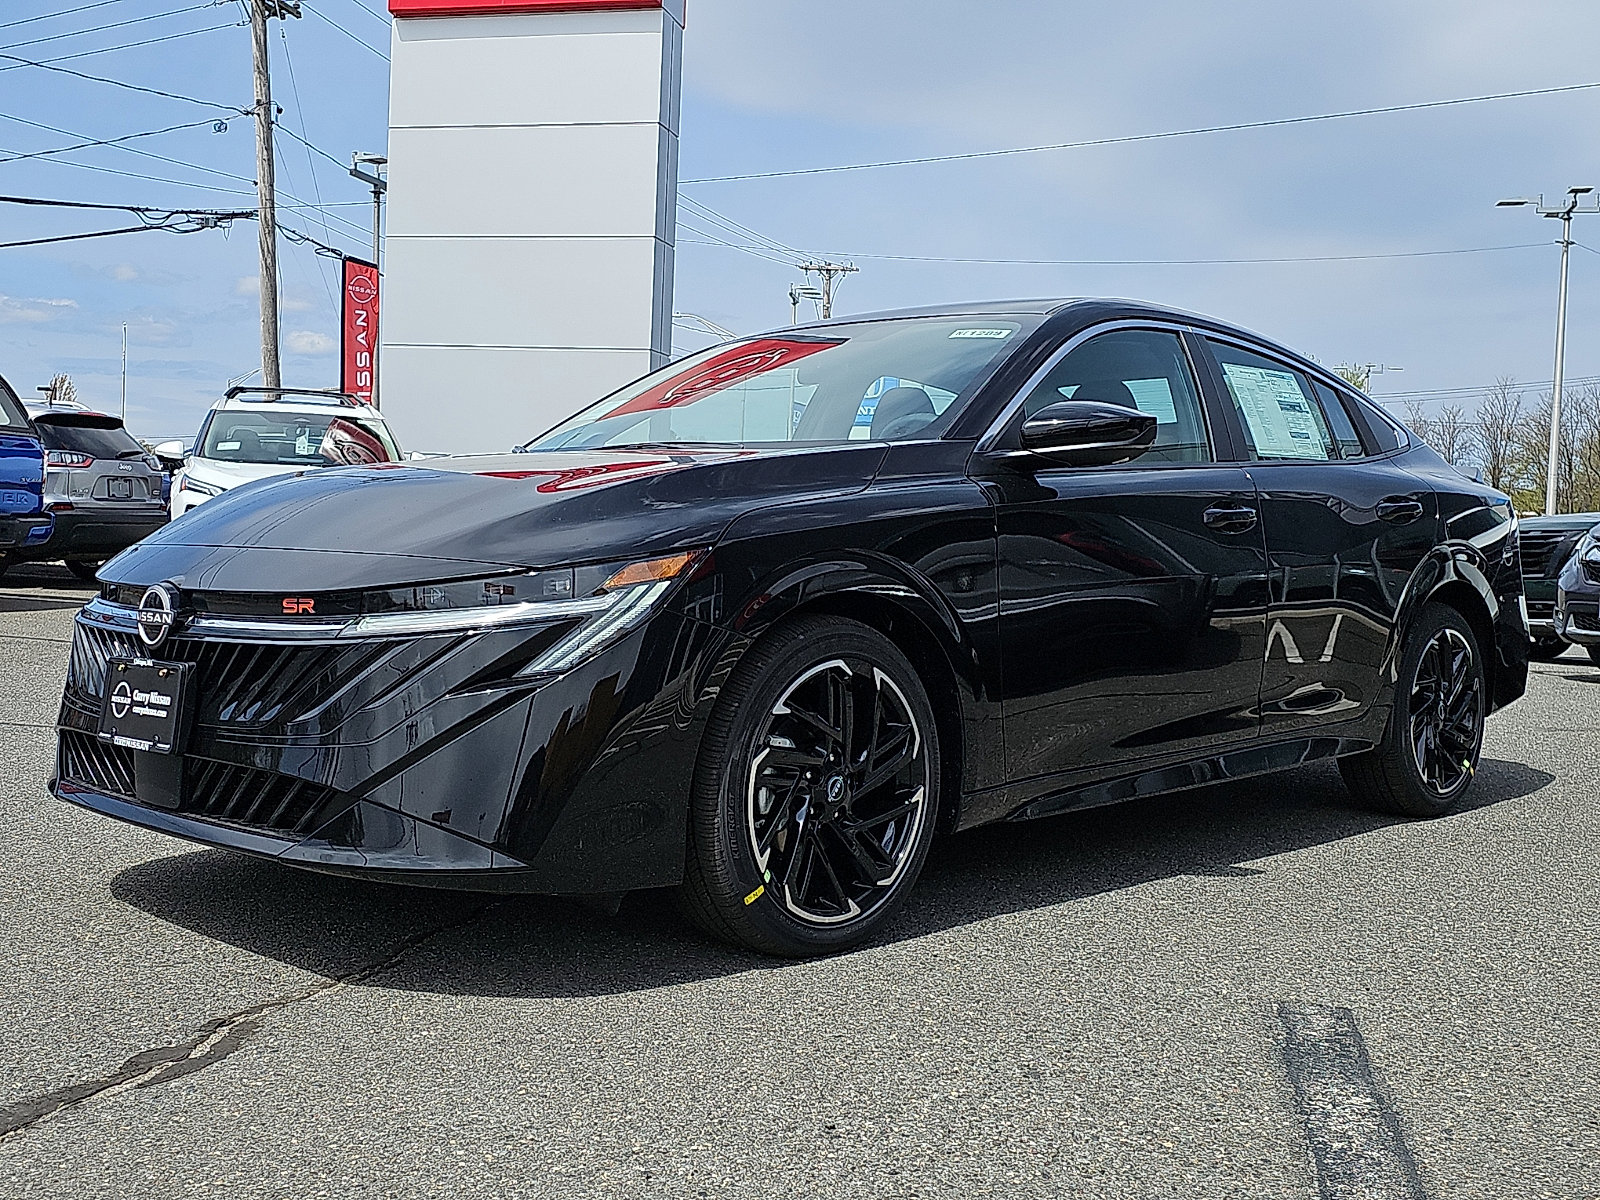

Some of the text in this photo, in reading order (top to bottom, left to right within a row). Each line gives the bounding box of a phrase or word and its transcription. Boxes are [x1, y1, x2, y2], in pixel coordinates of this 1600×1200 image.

[348, 285, 377, 296] NISSAN
[355, 309, 371, 397] ISSAN
[3, 493, 28, 504] ER
[282, 598, 316, 613] SR
